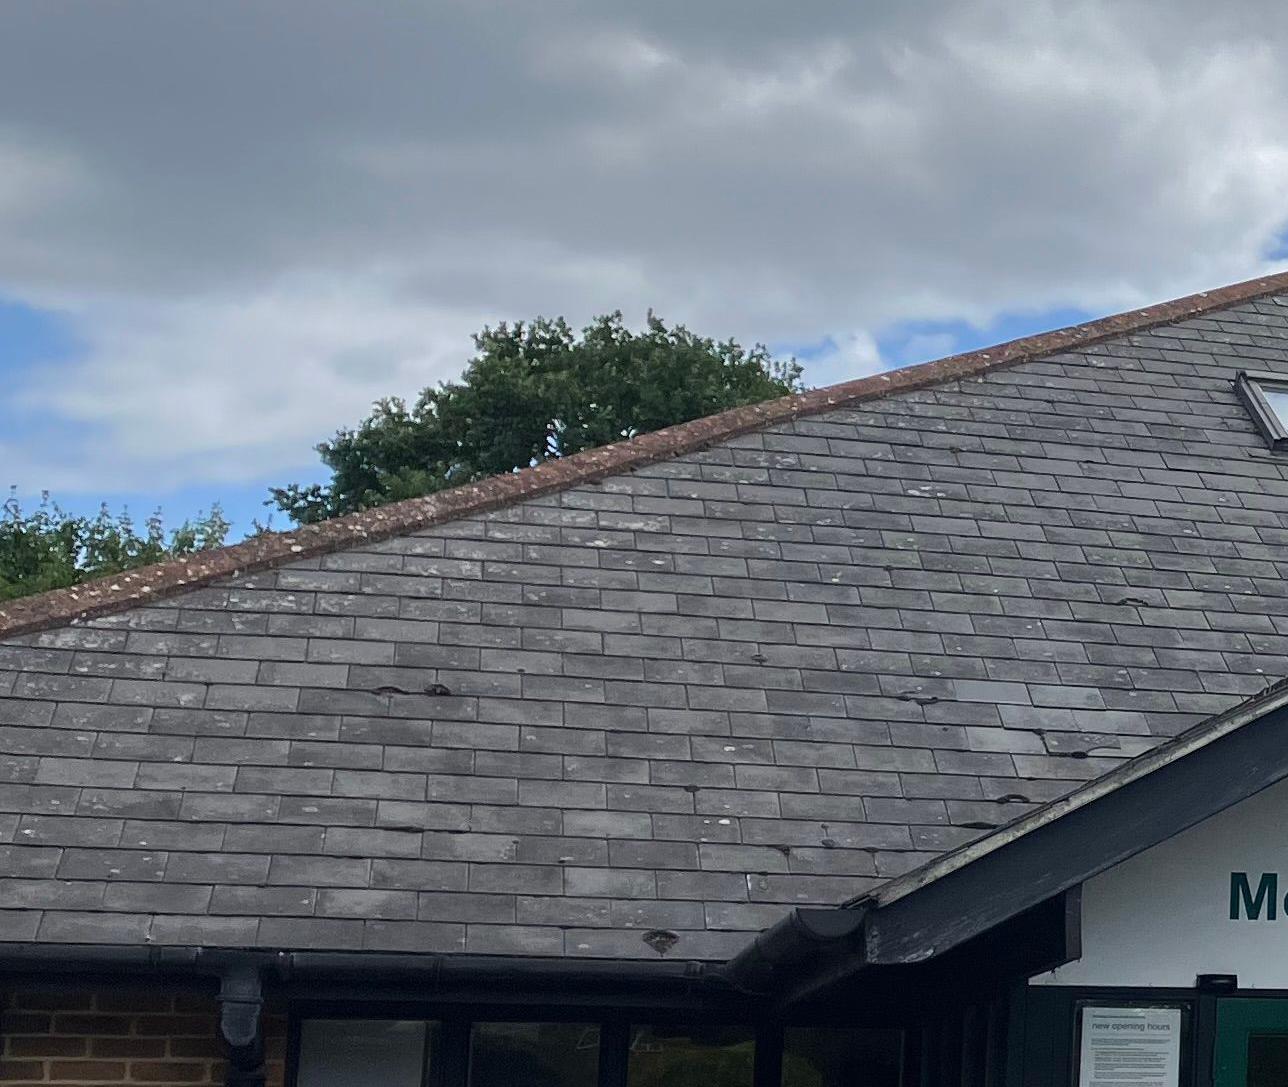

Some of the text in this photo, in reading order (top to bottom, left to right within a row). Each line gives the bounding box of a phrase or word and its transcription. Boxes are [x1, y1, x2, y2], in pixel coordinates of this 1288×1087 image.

[1091, 1022, 1171, 1033] new opening hours
